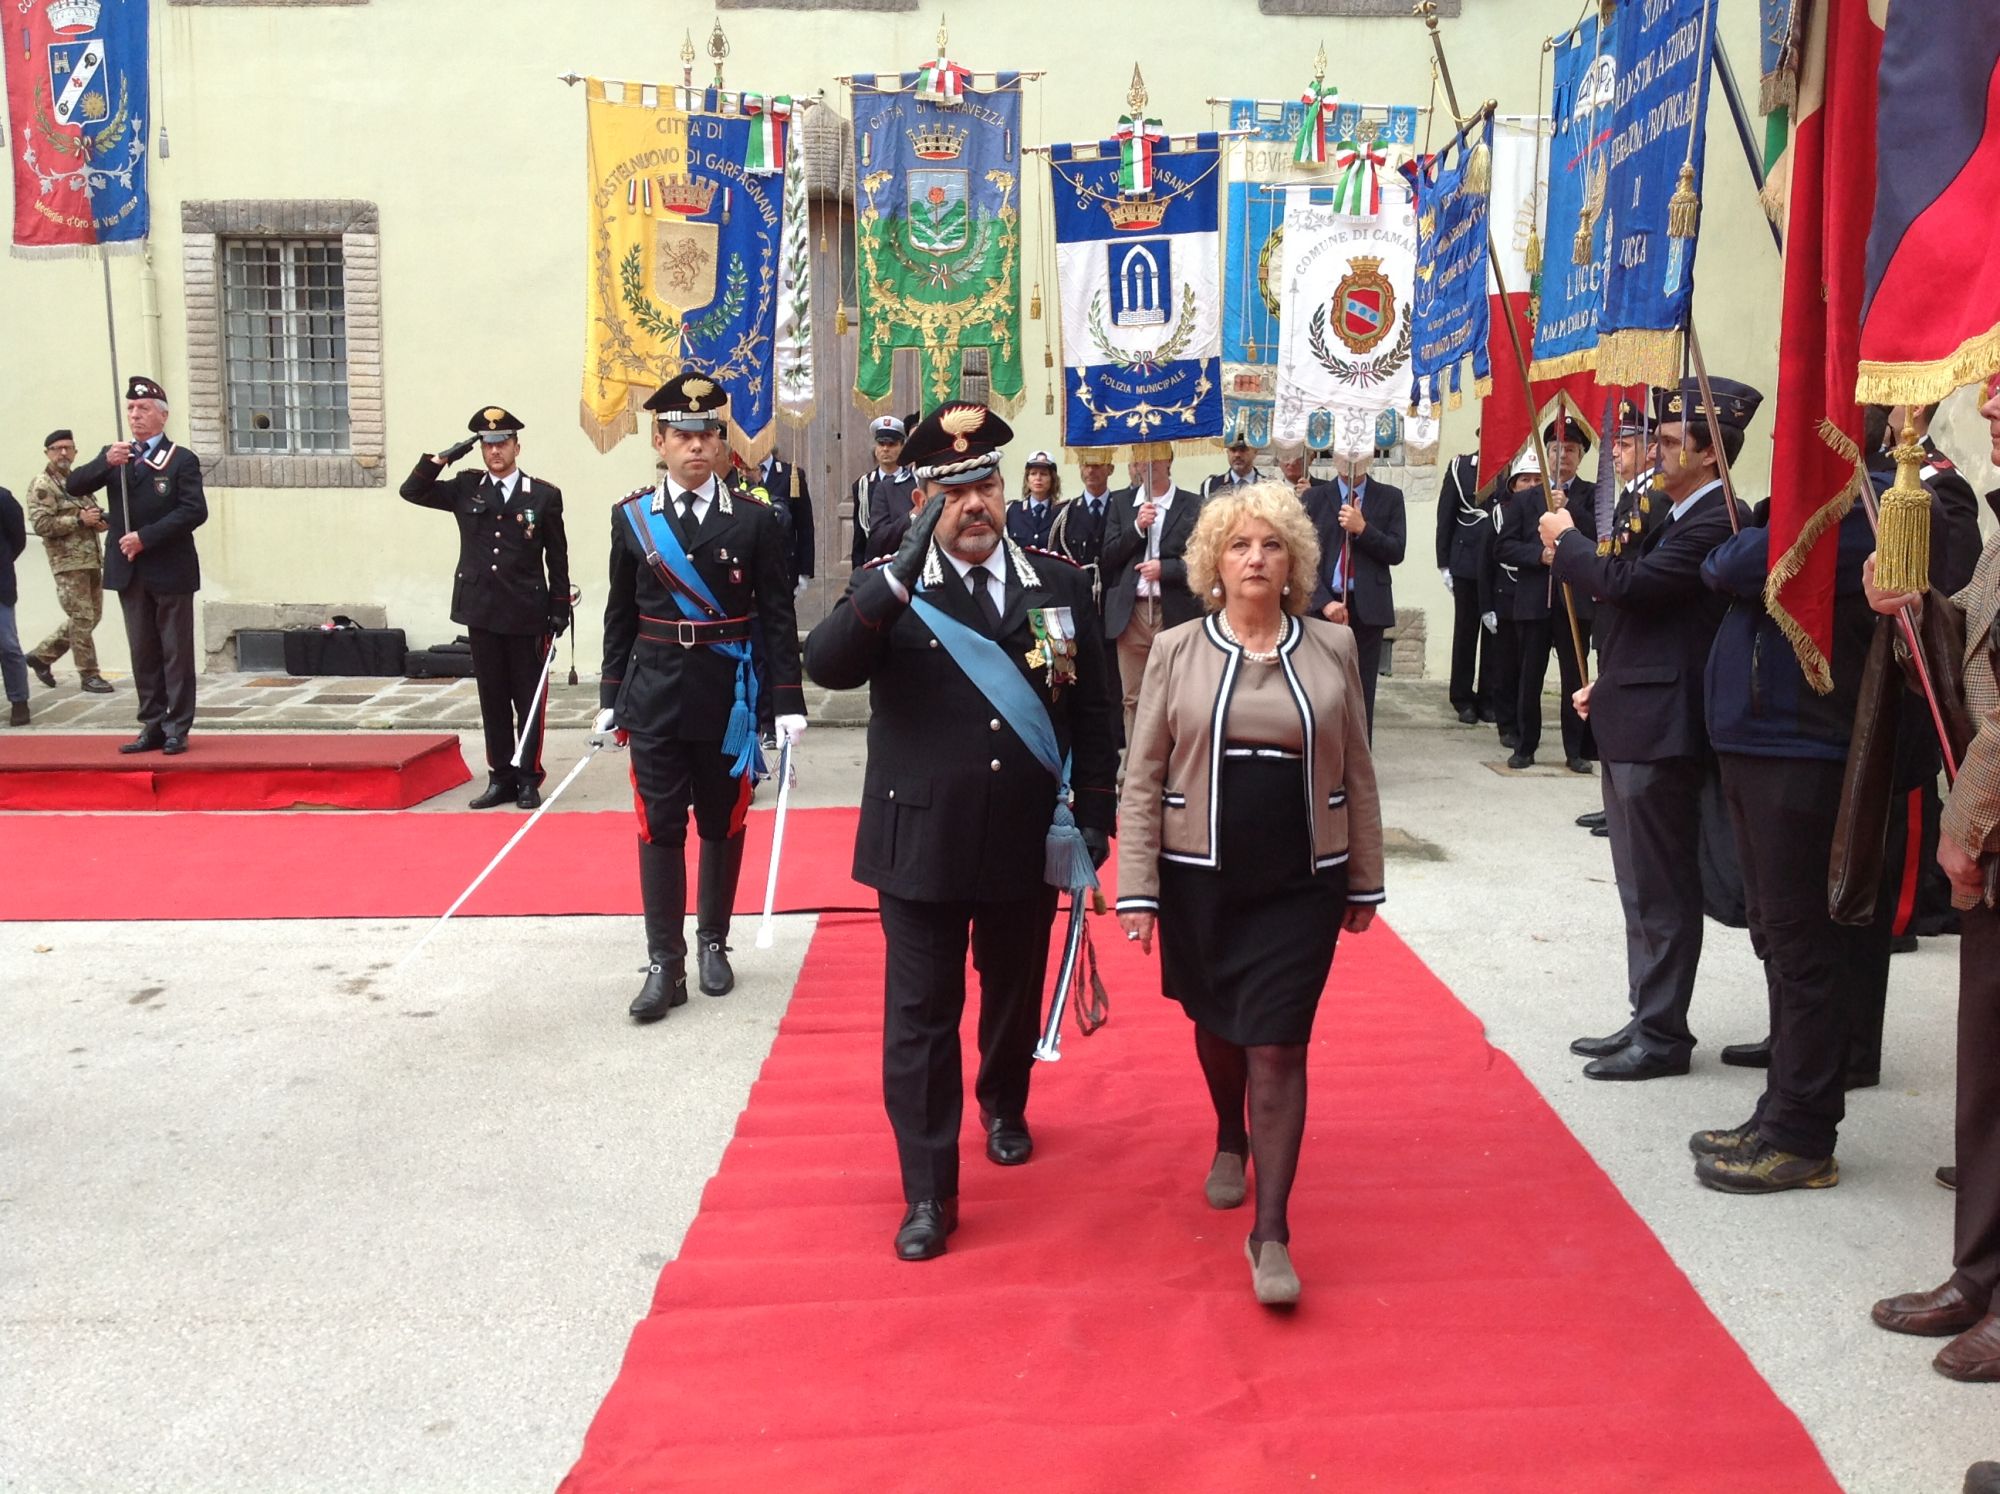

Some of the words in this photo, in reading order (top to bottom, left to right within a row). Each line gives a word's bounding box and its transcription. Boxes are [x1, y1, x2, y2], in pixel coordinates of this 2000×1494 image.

[706, 121, 722, 140] DI
[594, 148, 680, 210] CASTELNUOVO
[685, 150, 700, 166] DI
[705, 152, 779, 230] GARFAGNANA
[1296, 230, 1349, 275] COMUNE
[1352, 228, 1369, 240] DI
[1567, 261, 1601, 300] LUCC
[1100, 373, 1131, 394] POLIZIA
[1135, 368, 1187, 395] MUNICIPALE
